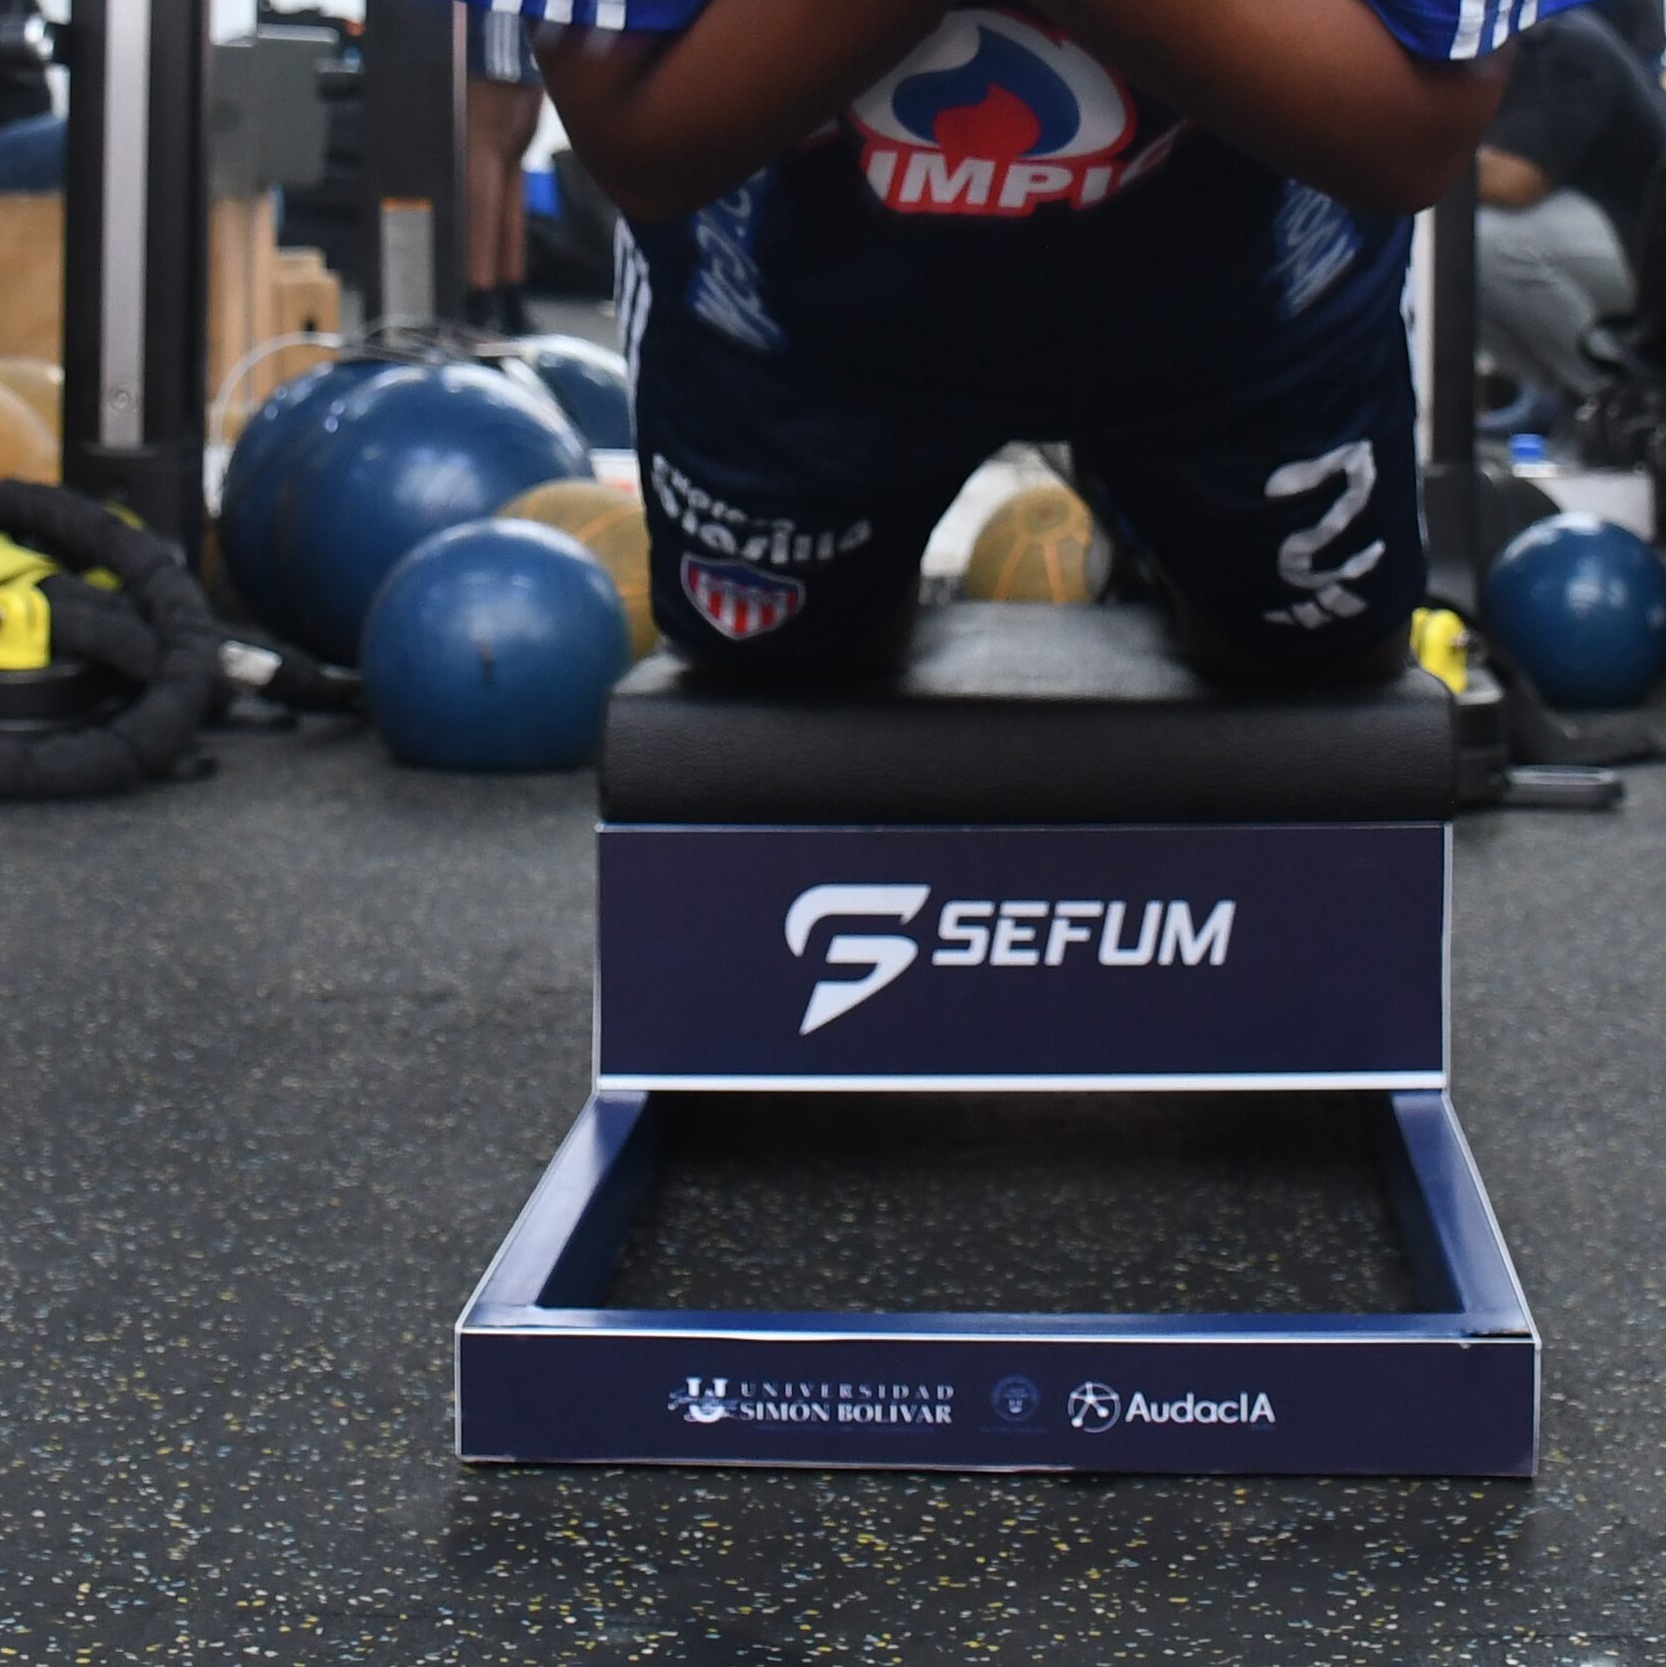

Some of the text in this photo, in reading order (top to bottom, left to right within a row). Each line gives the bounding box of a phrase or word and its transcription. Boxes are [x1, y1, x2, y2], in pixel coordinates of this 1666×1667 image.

[1264, 439, 1386, 589] 2
[932, 900, 1237, 966] SEFUM
[740, 1382, 955, 1400] UNIVERSIDAD
[1124, 1391, 1276, 1423] AudacIA
